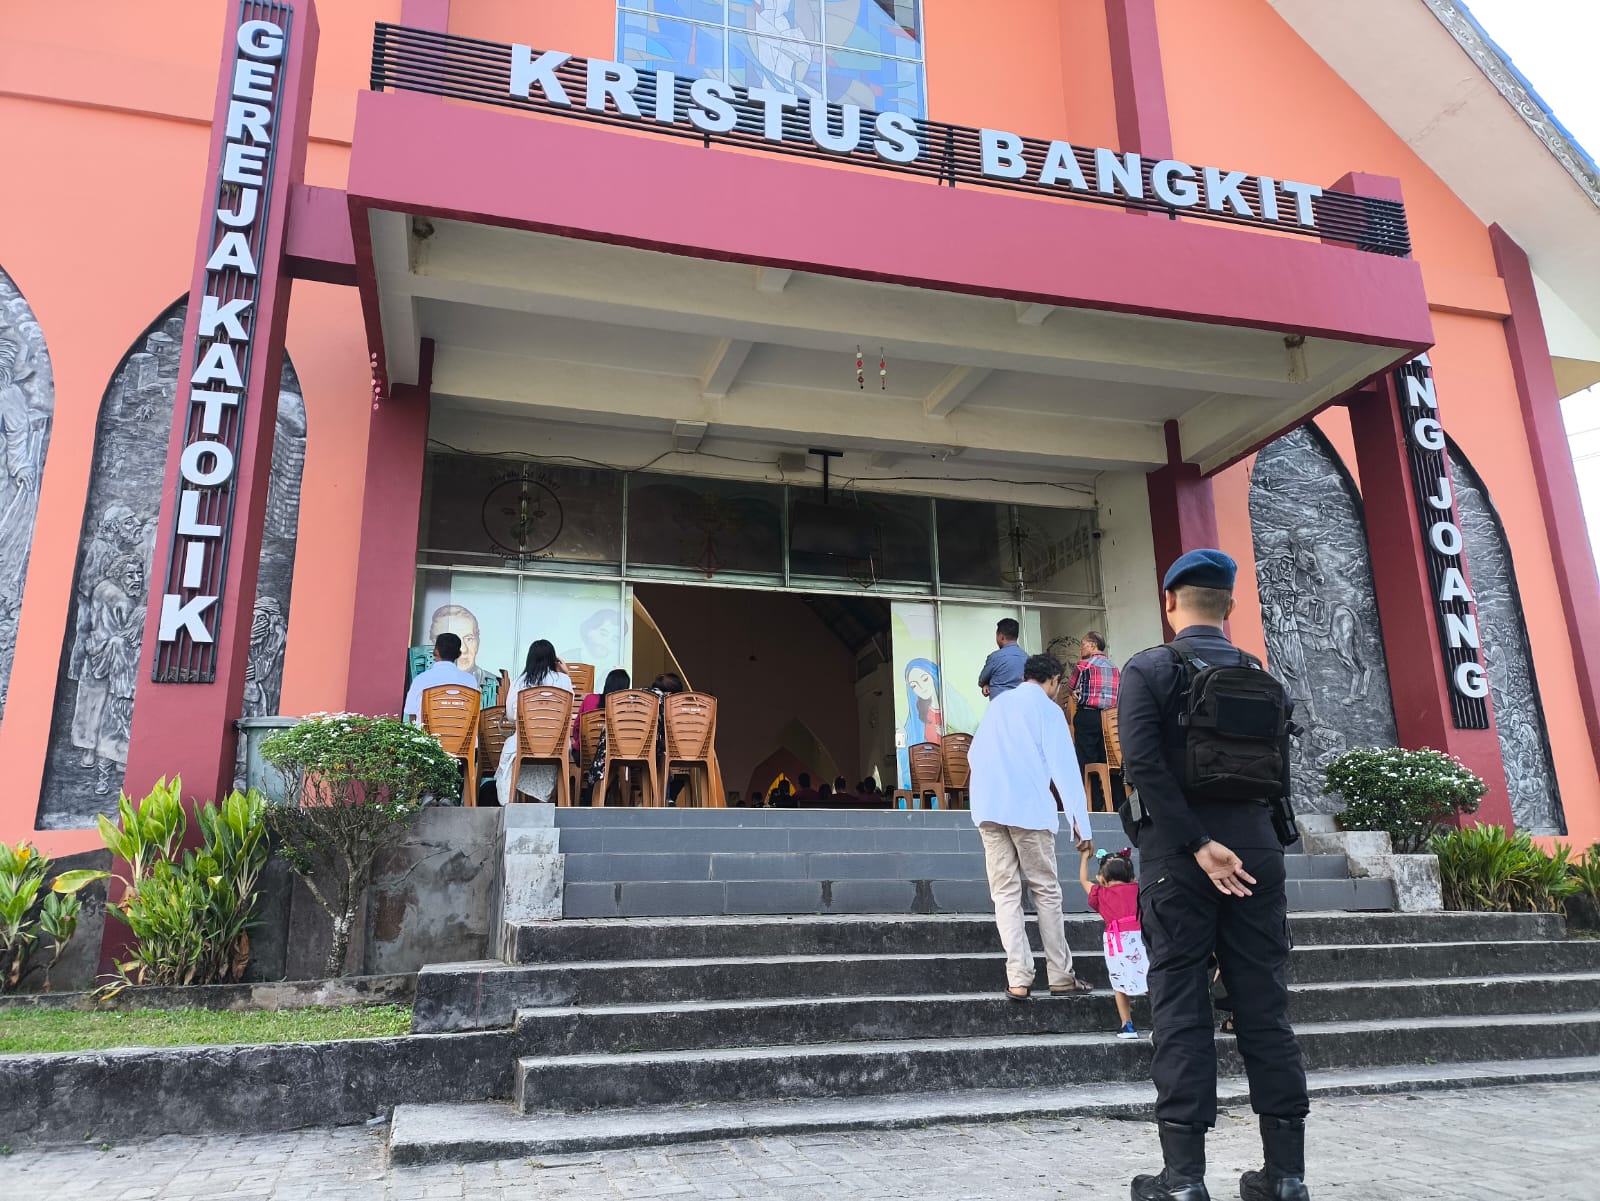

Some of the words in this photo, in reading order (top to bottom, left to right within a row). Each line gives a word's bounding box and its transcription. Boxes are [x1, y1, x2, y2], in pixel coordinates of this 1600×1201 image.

[205, 20, 284, 275] GEREJA
[508, 43, 919, 164] KRISTUS
[979, 127, 1323, 227] BANGKIT
[158, 295, 254, 644] KATOLIK
[1428, 476, 1489, 699] JOANG
